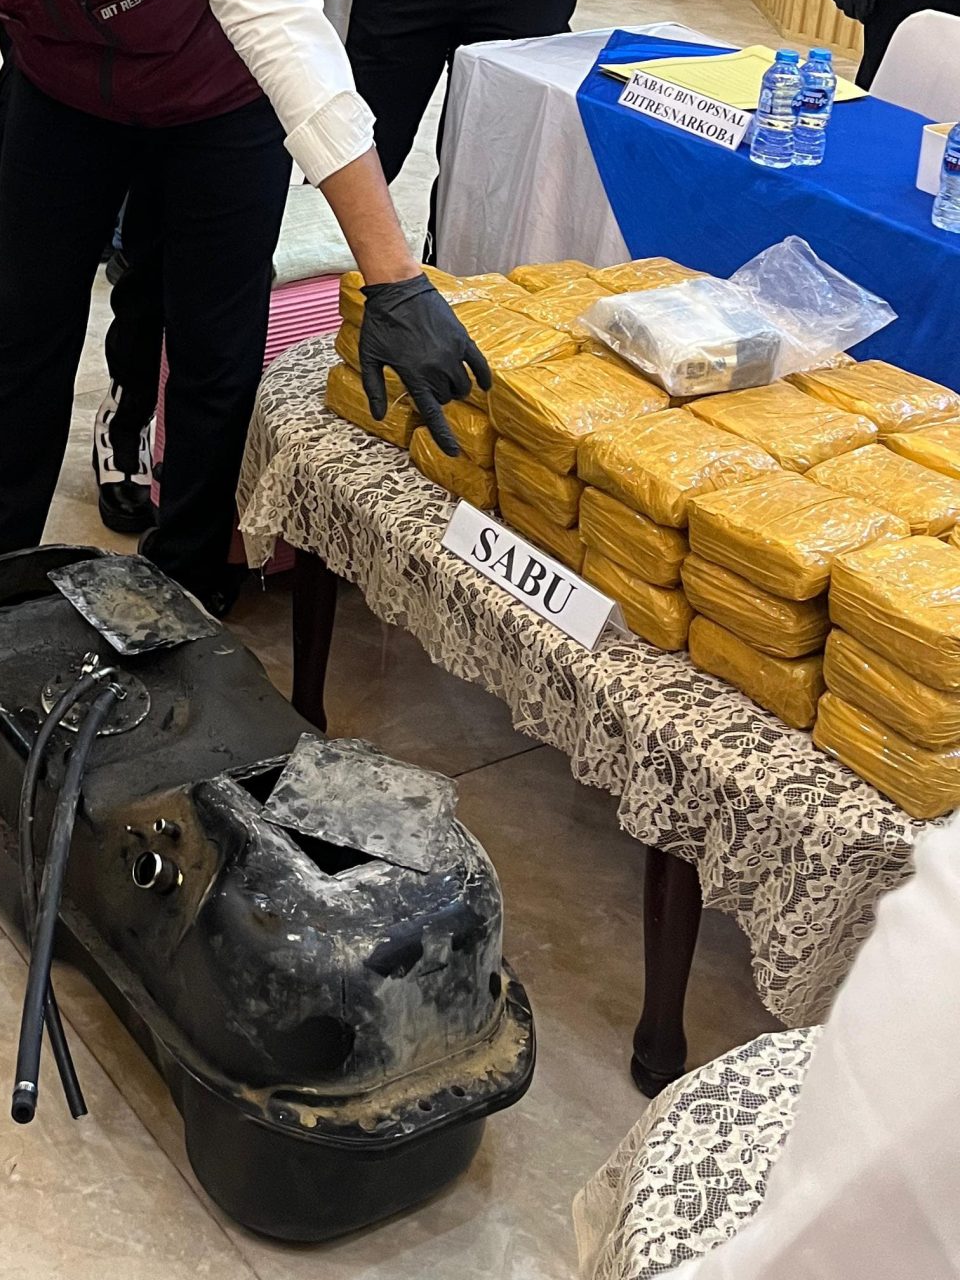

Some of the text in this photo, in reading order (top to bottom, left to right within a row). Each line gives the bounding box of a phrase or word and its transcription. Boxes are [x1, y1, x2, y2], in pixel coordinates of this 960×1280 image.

[100, 4, 119, 20] DIT
[623, 90, 736, 146] DITRESNARKOBA
[632, 73, 675, 98] KABAG
[673, 89, 698, 107] BIN
[697, 99, 746, 128] OPSNAL
[471, 527, 578, 614] SABU
